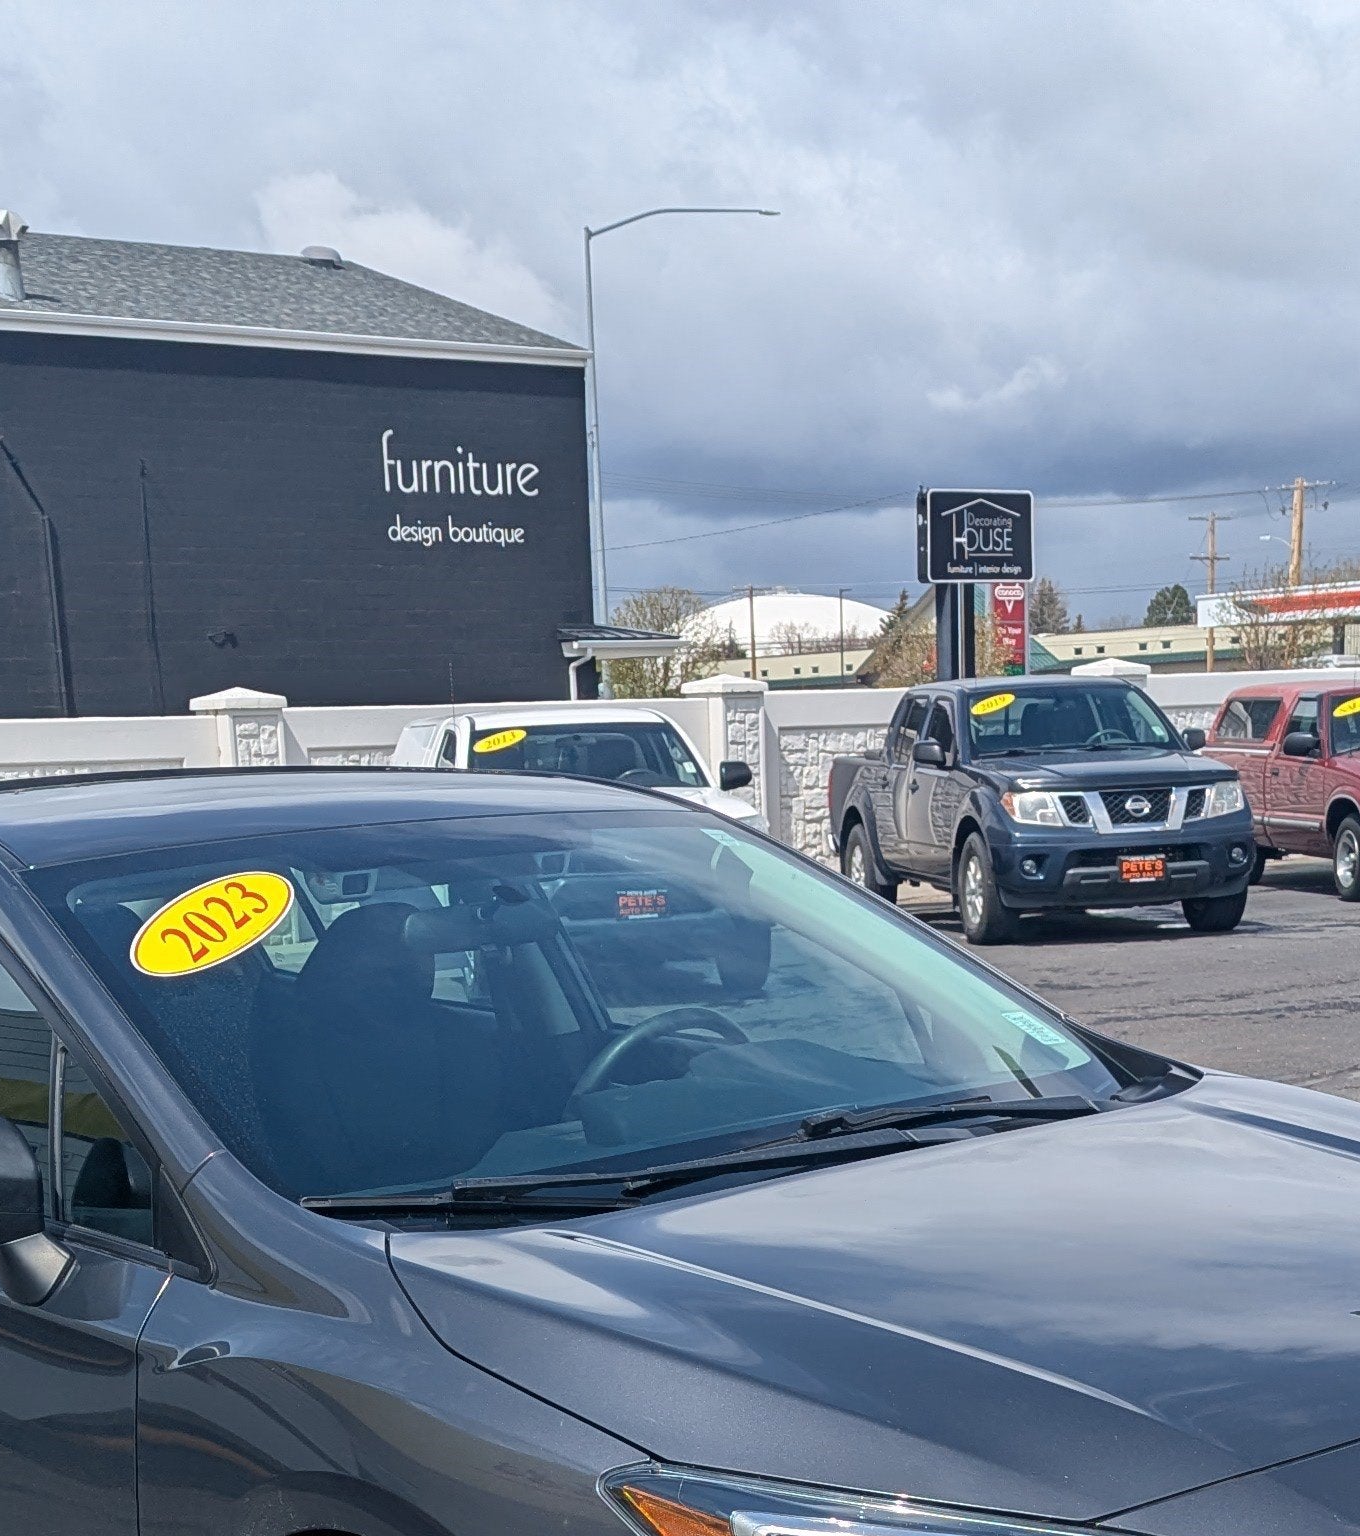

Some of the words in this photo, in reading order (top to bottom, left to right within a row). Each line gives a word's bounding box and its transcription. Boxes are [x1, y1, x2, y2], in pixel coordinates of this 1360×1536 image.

[381, 429, 540, 497] furniture
[967, 512, 1013, 528] Decorating
[387, 513, 443, 547] design
[447, 515, 525, 548] boutique
[952, 509, 1014, 560] HOUSE
[947, 562, 974, 574] furniture
[978, 564, 1001, 574] interior
[1001, 562, 1022, 575] design
[486, 731, 516, 750] 2013
[1122, 860, 1163, 871] PETE'S
[619, 895, 666, 906] PETE'S
[160, 881, 269, 964] 2023
